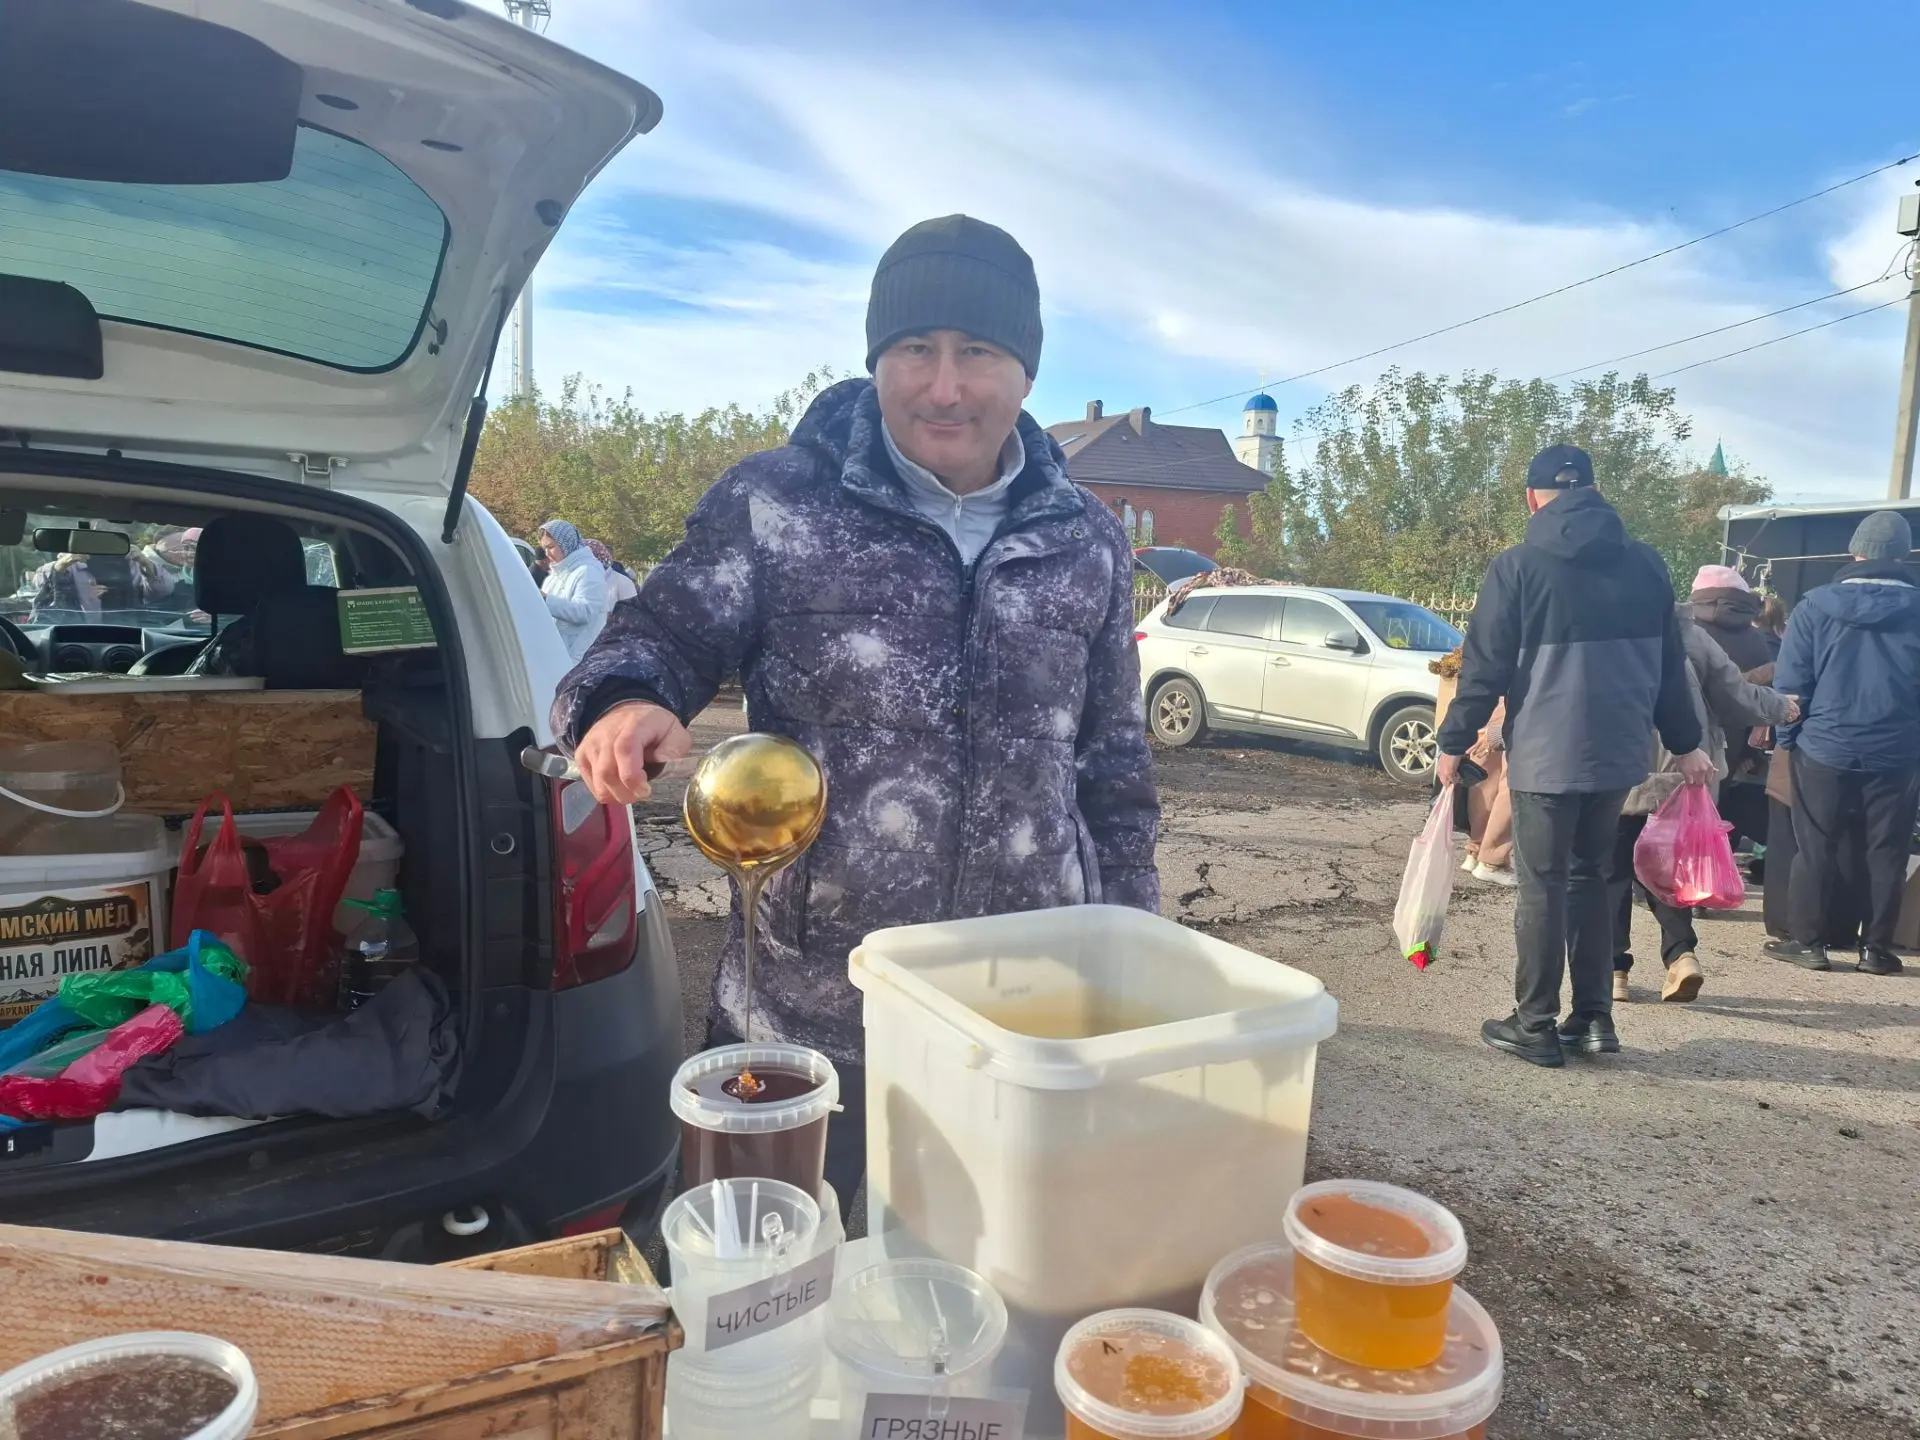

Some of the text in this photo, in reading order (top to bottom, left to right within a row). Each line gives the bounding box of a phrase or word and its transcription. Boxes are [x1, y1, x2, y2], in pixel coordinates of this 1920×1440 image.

[85, 902, 130, 930] МЁД
[53, 945, 113, 975] ЛИПА
[717, 1279, 817, 1333] ЧИСТЫЕ
[872, 1418, 1002, 1440] ГРЯЗНЫЕ
